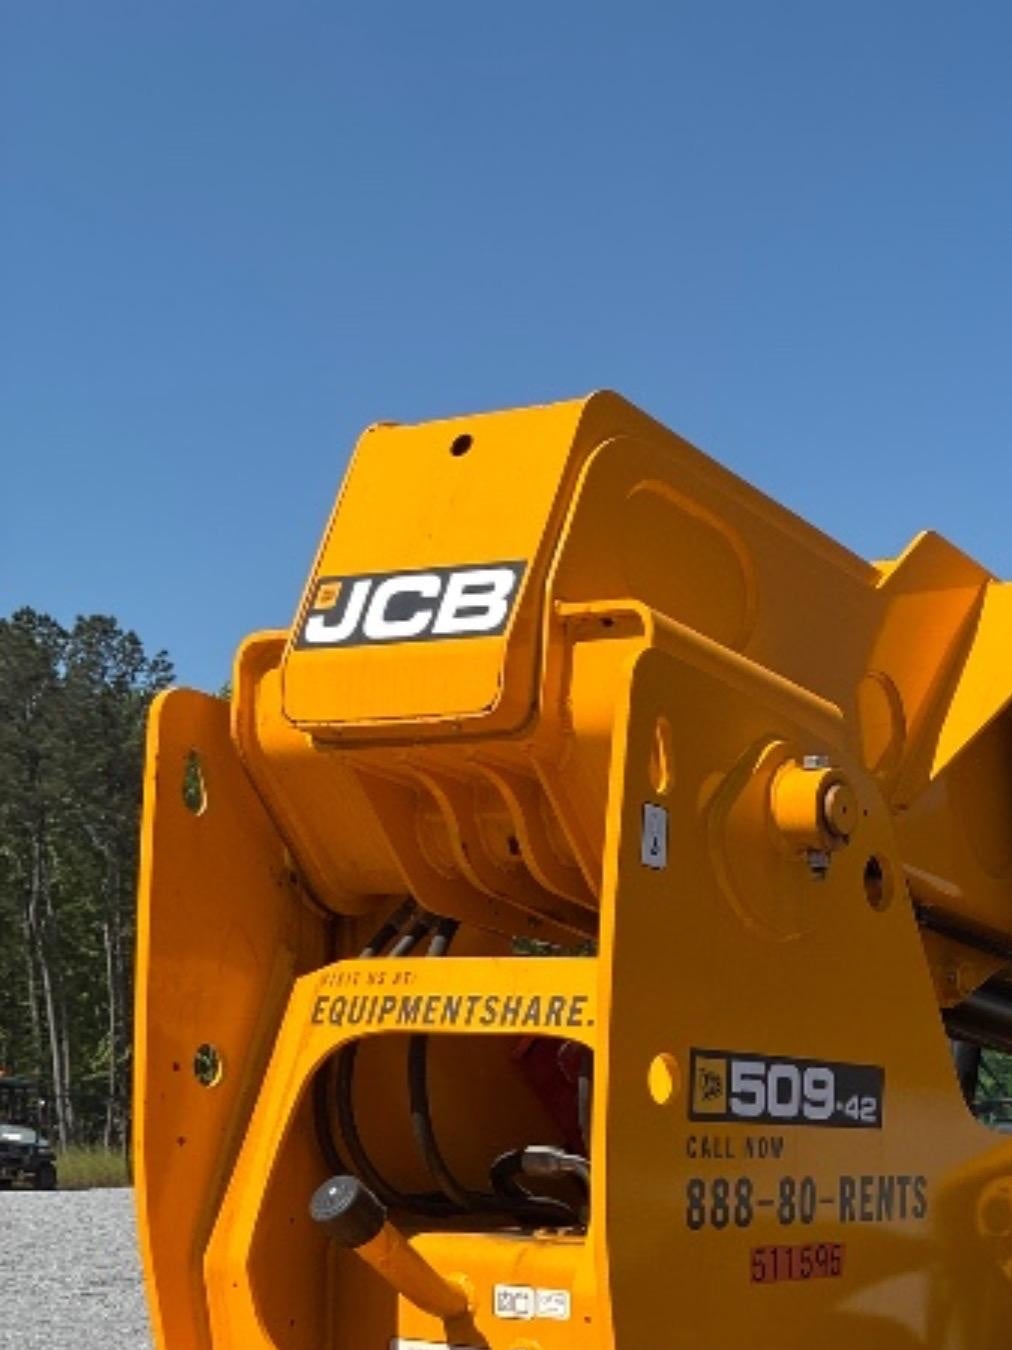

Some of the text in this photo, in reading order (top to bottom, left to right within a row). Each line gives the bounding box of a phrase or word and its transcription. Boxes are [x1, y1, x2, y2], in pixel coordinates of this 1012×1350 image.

[304, 568, 516, 644] JCB
[686, 1136, 784, 1159] CALL NOW
[686, 1175, 928, 1231] 888-80-RENTS
[751, 1245, 842, 1284] 511595
